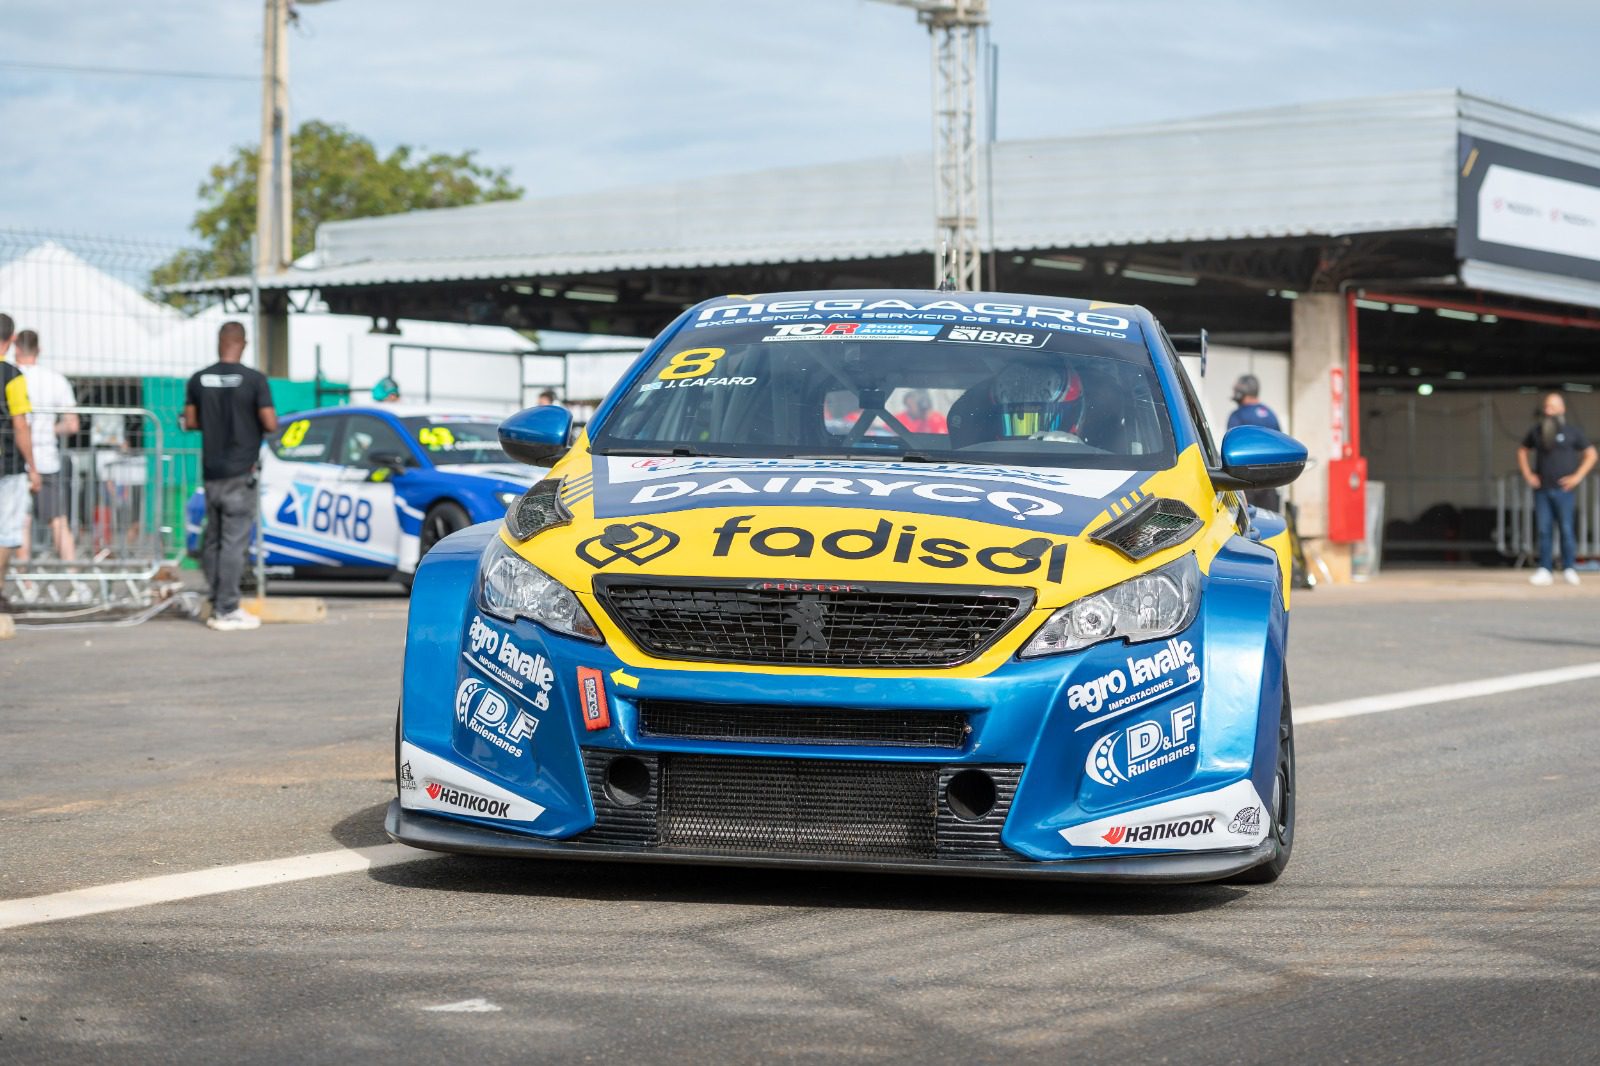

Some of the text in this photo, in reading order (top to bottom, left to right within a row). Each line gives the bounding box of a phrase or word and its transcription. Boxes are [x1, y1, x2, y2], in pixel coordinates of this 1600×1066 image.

[694, 312, 1127, 339] EXCELENCIA AL SERVICIO DE SU NEGOCIO
[697, 298, 1130, 330] MEGAAGRO
[772, 322, 861, 337] TCR
[977, 330, 1035, 345] BRB
[658, 347, 726, 380] 8
[311, 488, 372, 543] BRB
[629, 477, 1064, 520] DAIRYCO
[712, 514, 1068, 585] fadisol
[763, 582, 854, 592] PEUGEOT
[469, 615, 555, 691] agro lavalle
[478, 654, 524, 690] IMPORTACIONES
[1067, 637, 1195, 713] agro lavalle
[1108, 678, 1174, 711] IMPORTACIONES
[474, 687, 540, 744] D&F
[1126, 701, 1196, 765] D&F
[468, 719, 523, 758] Rulemanes
[1127, 743, 1196, 779] Rulemanes
